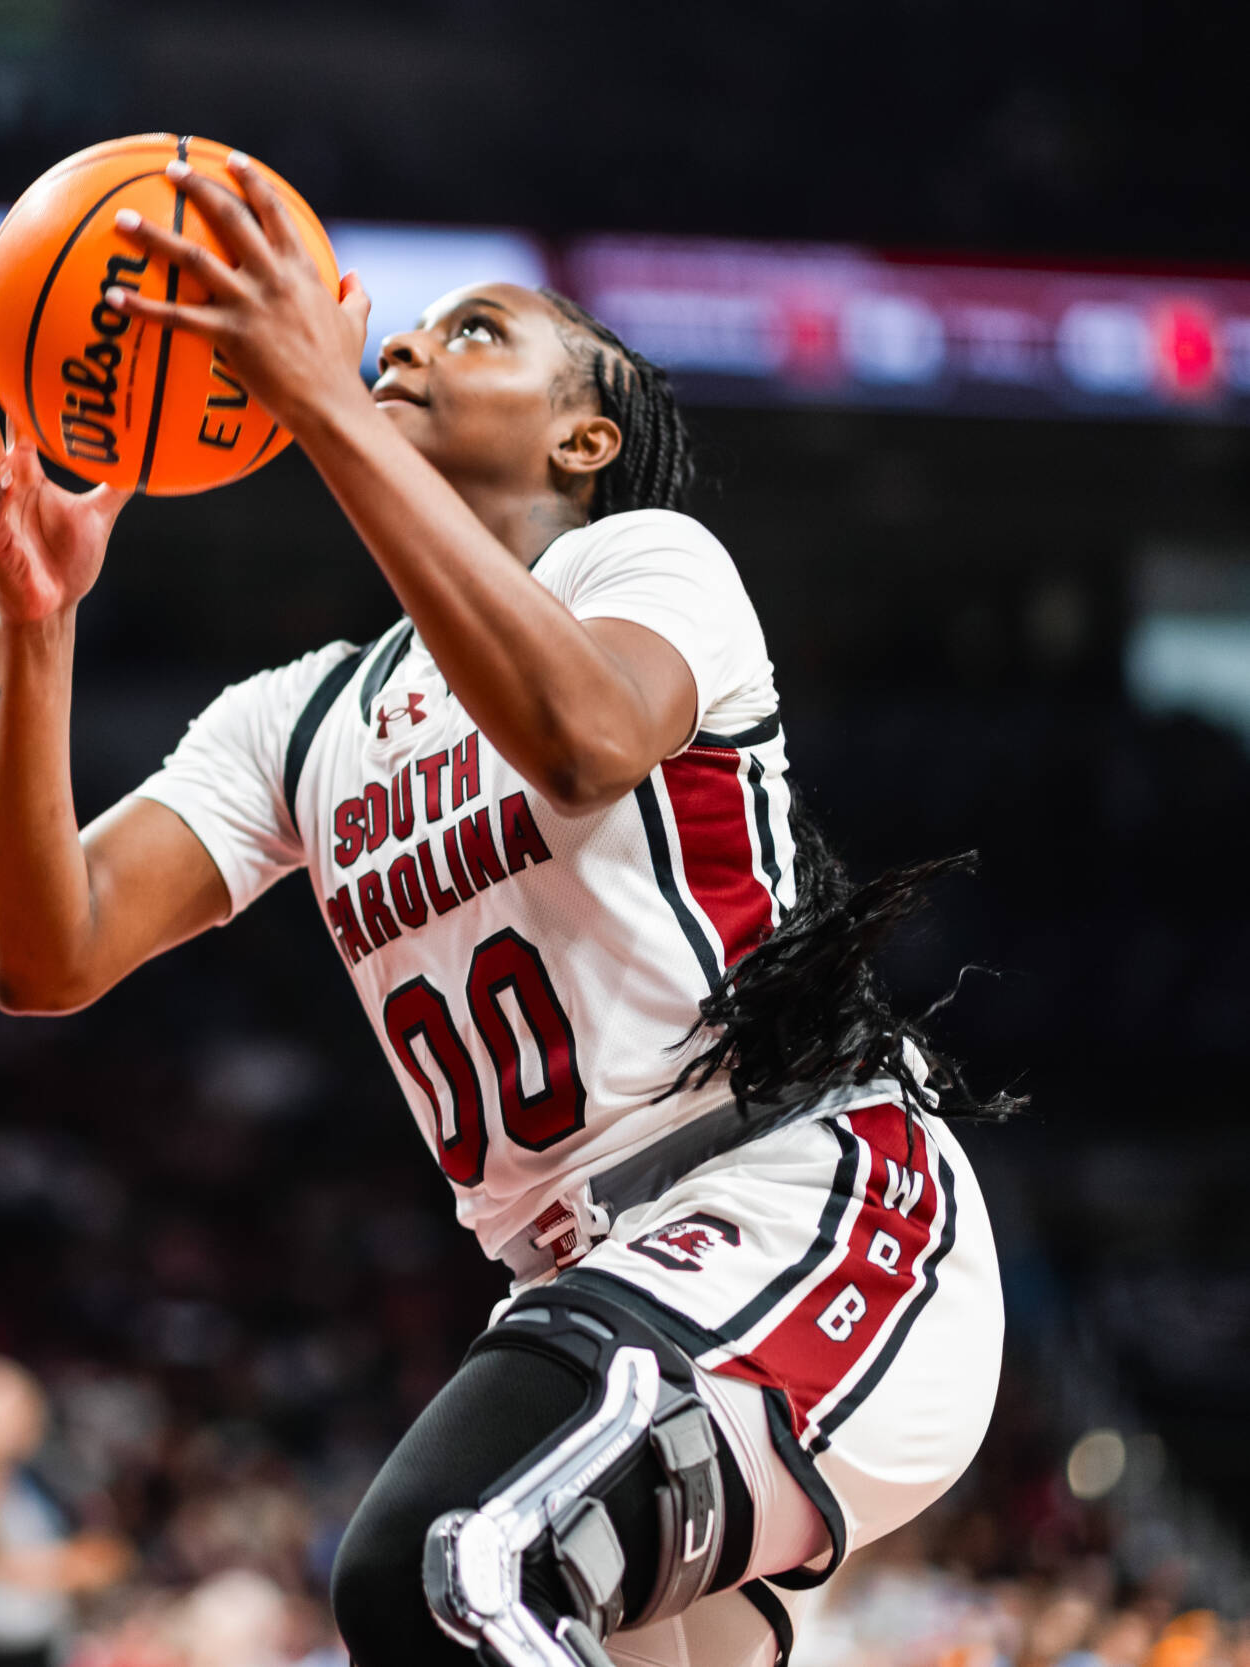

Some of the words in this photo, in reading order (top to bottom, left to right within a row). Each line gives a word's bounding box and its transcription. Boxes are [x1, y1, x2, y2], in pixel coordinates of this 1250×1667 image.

[60, 254, 149, 464] Wilson
[334, 729, 481, 869] SOUTH
[383, 925, 587, 1189] 00
